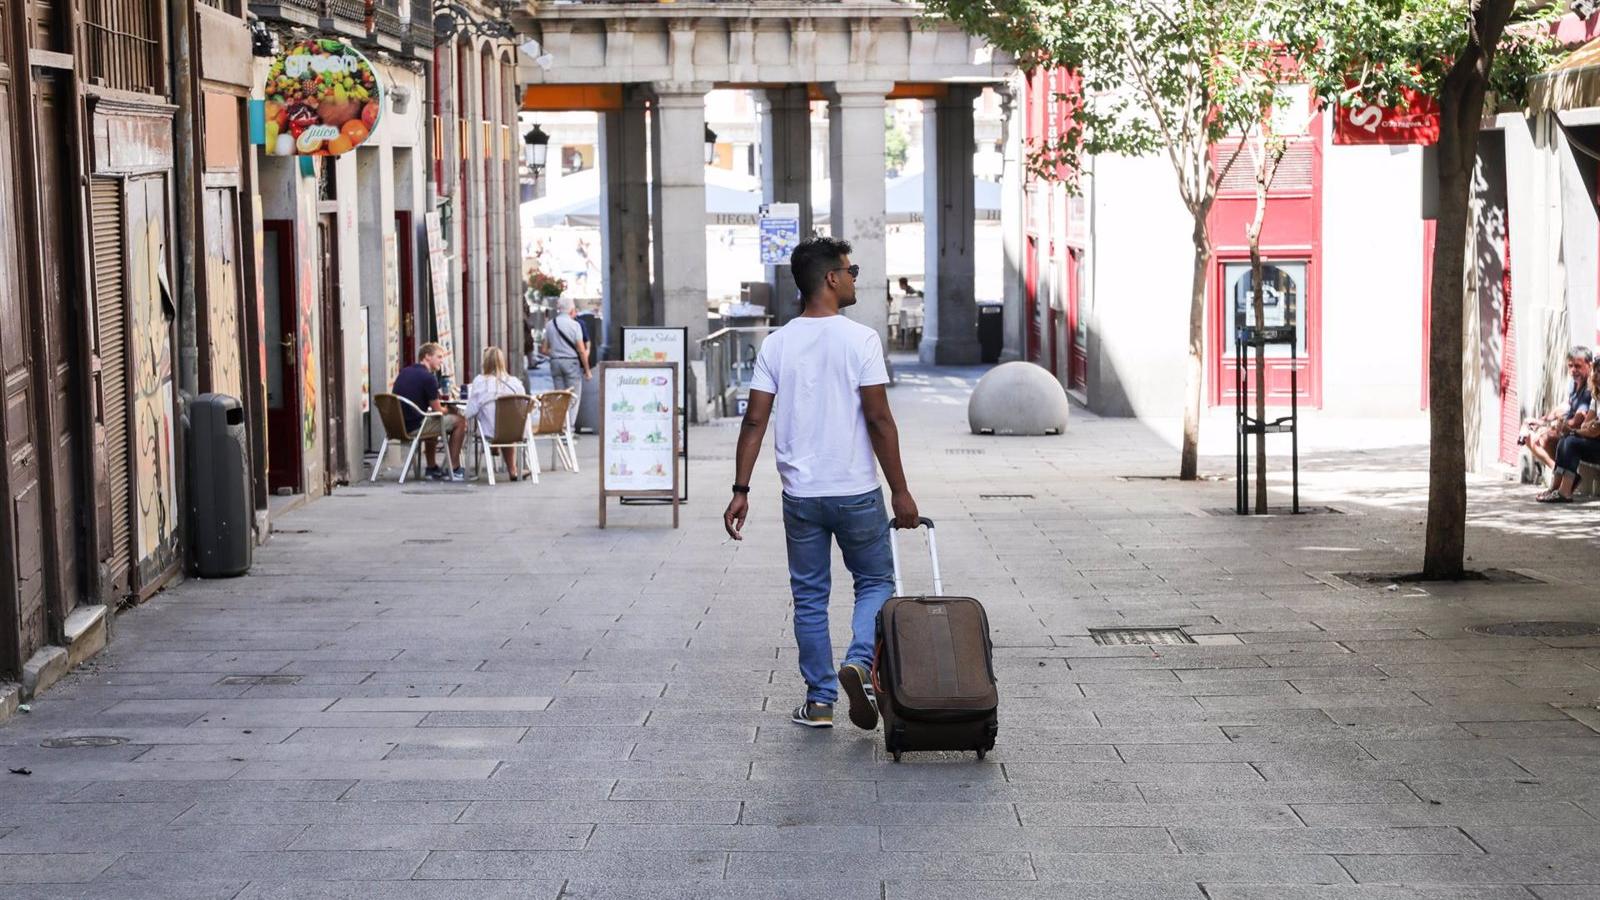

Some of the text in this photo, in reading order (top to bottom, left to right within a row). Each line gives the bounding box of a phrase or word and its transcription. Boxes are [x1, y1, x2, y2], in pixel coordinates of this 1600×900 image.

[285, 54, 358, 77] green
[304, 128, 336, 142] juice
[715, 213, 758, 225] HEGA
